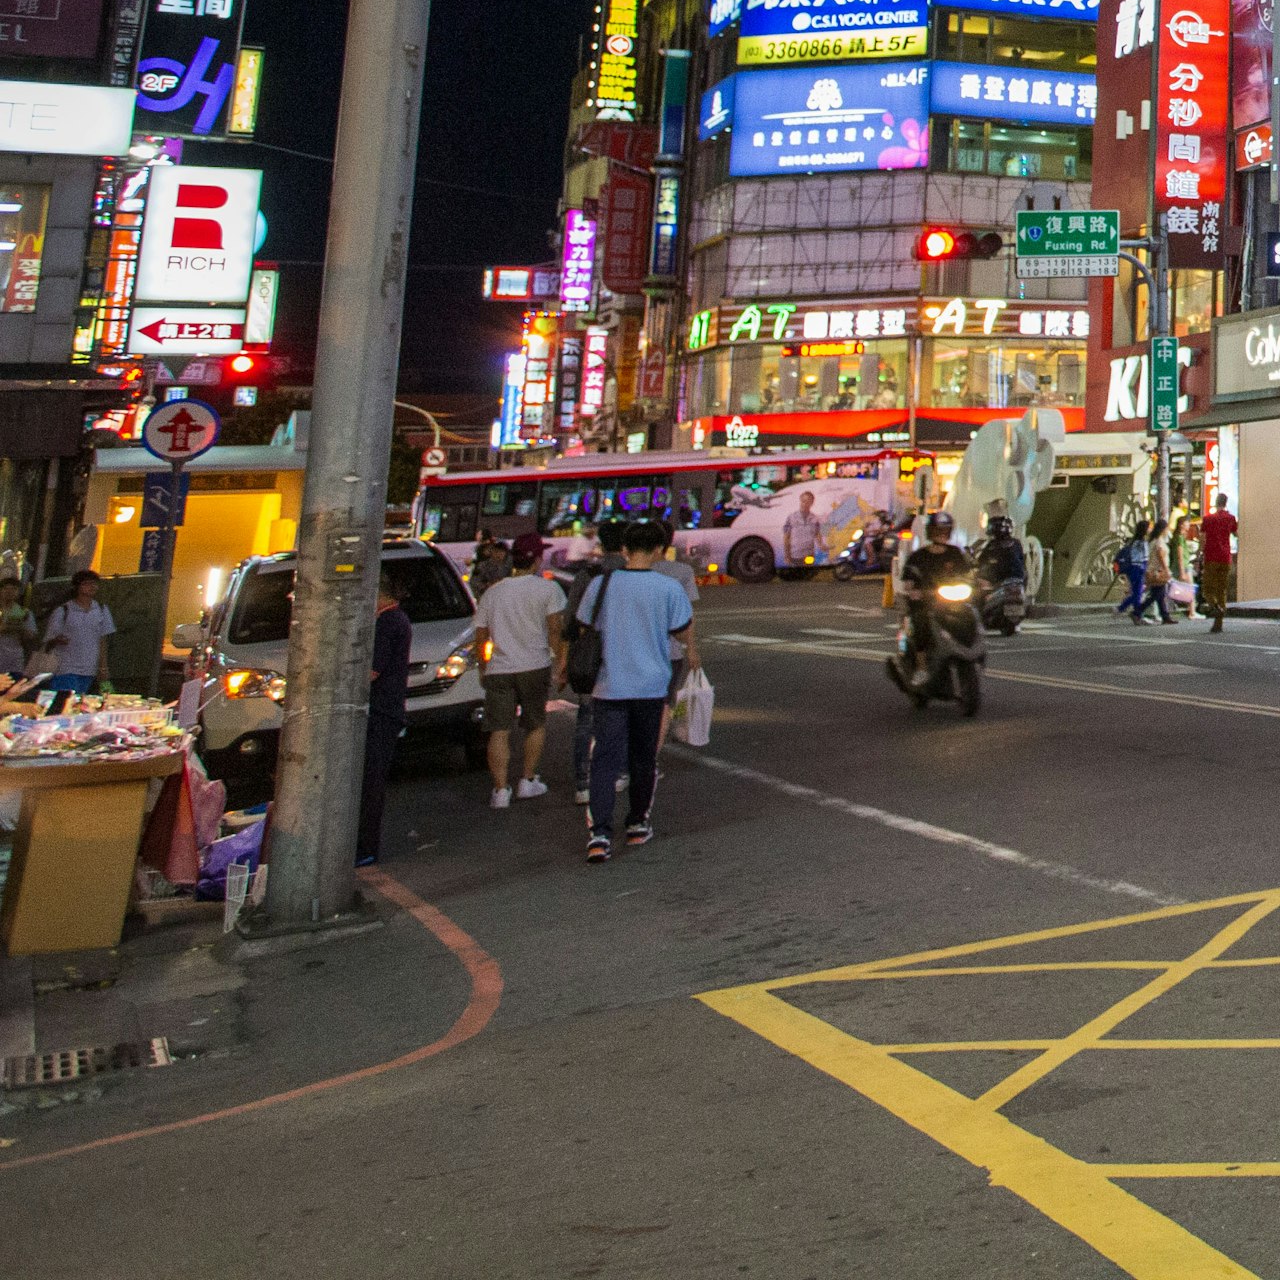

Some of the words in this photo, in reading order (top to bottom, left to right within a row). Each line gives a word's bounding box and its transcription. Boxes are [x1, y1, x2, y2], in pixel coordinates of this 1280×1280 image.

[874, 10, 919, 25] CENTER
[765, 38, 843, 60] 3360866
[140, 73, 179, 92] 2F
[1165, 62, 1204, 236] 分秒間鐘錶
[1045, 216, 1108, 235] 復興路
[1201, 201, 1221, 253] 潮流館
[1045, 241, 1083, 252] Fuxing
[1090, 240, 1108, 251] Rd.
[167, 255, 226, 271] RICH
[1025, 258, 1067, 267] 69-119
[1071, 258, 1118, 267] 123-135
[1019, 268, 1067, 277] 110-156
[1071, 268, 1118, 276] 158-184
[1156, 345, 1174, 421] 中正路
